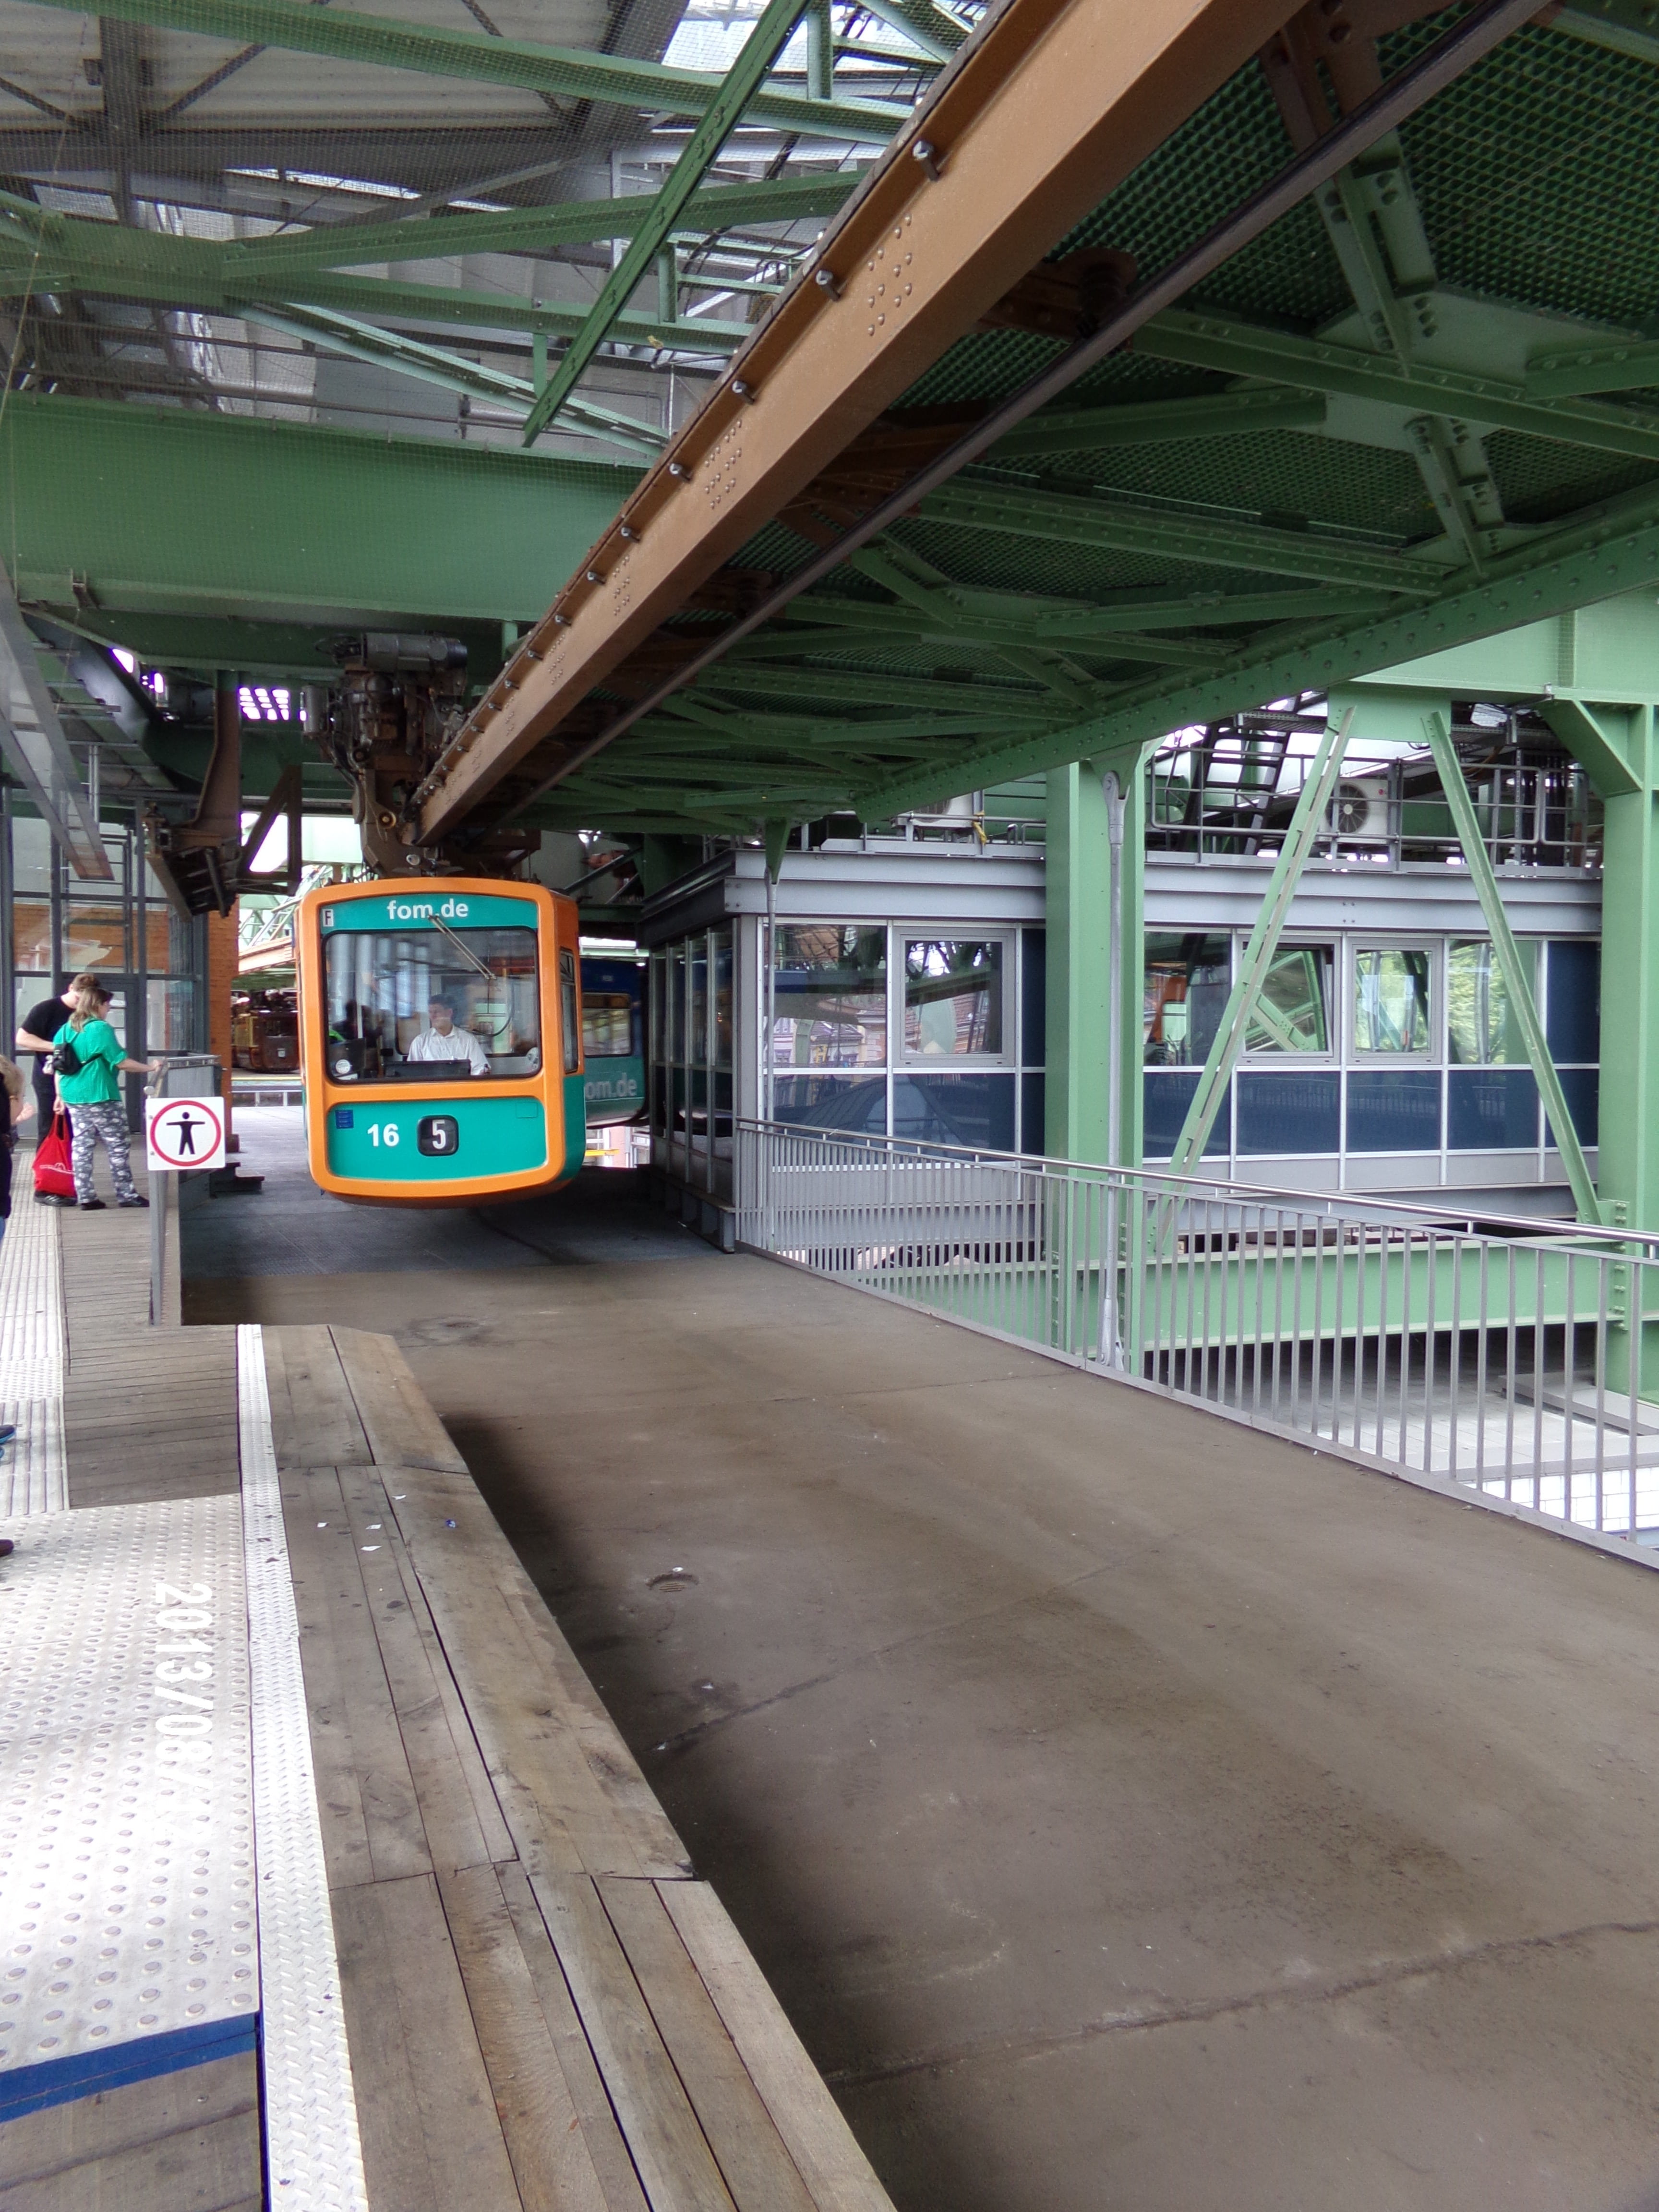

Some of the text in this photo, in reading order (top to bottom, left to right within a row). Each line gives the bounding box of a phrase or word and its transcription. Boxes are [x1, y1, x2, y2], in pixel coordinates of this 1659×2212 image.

[324, 910, 331, 926] F
[387, 898, 469, 920] fom.de
[585, 1072, 637, 1100] om.de
[367, 1123, 400, 1147] 16
[432, 1119, 446, 1149] 5
